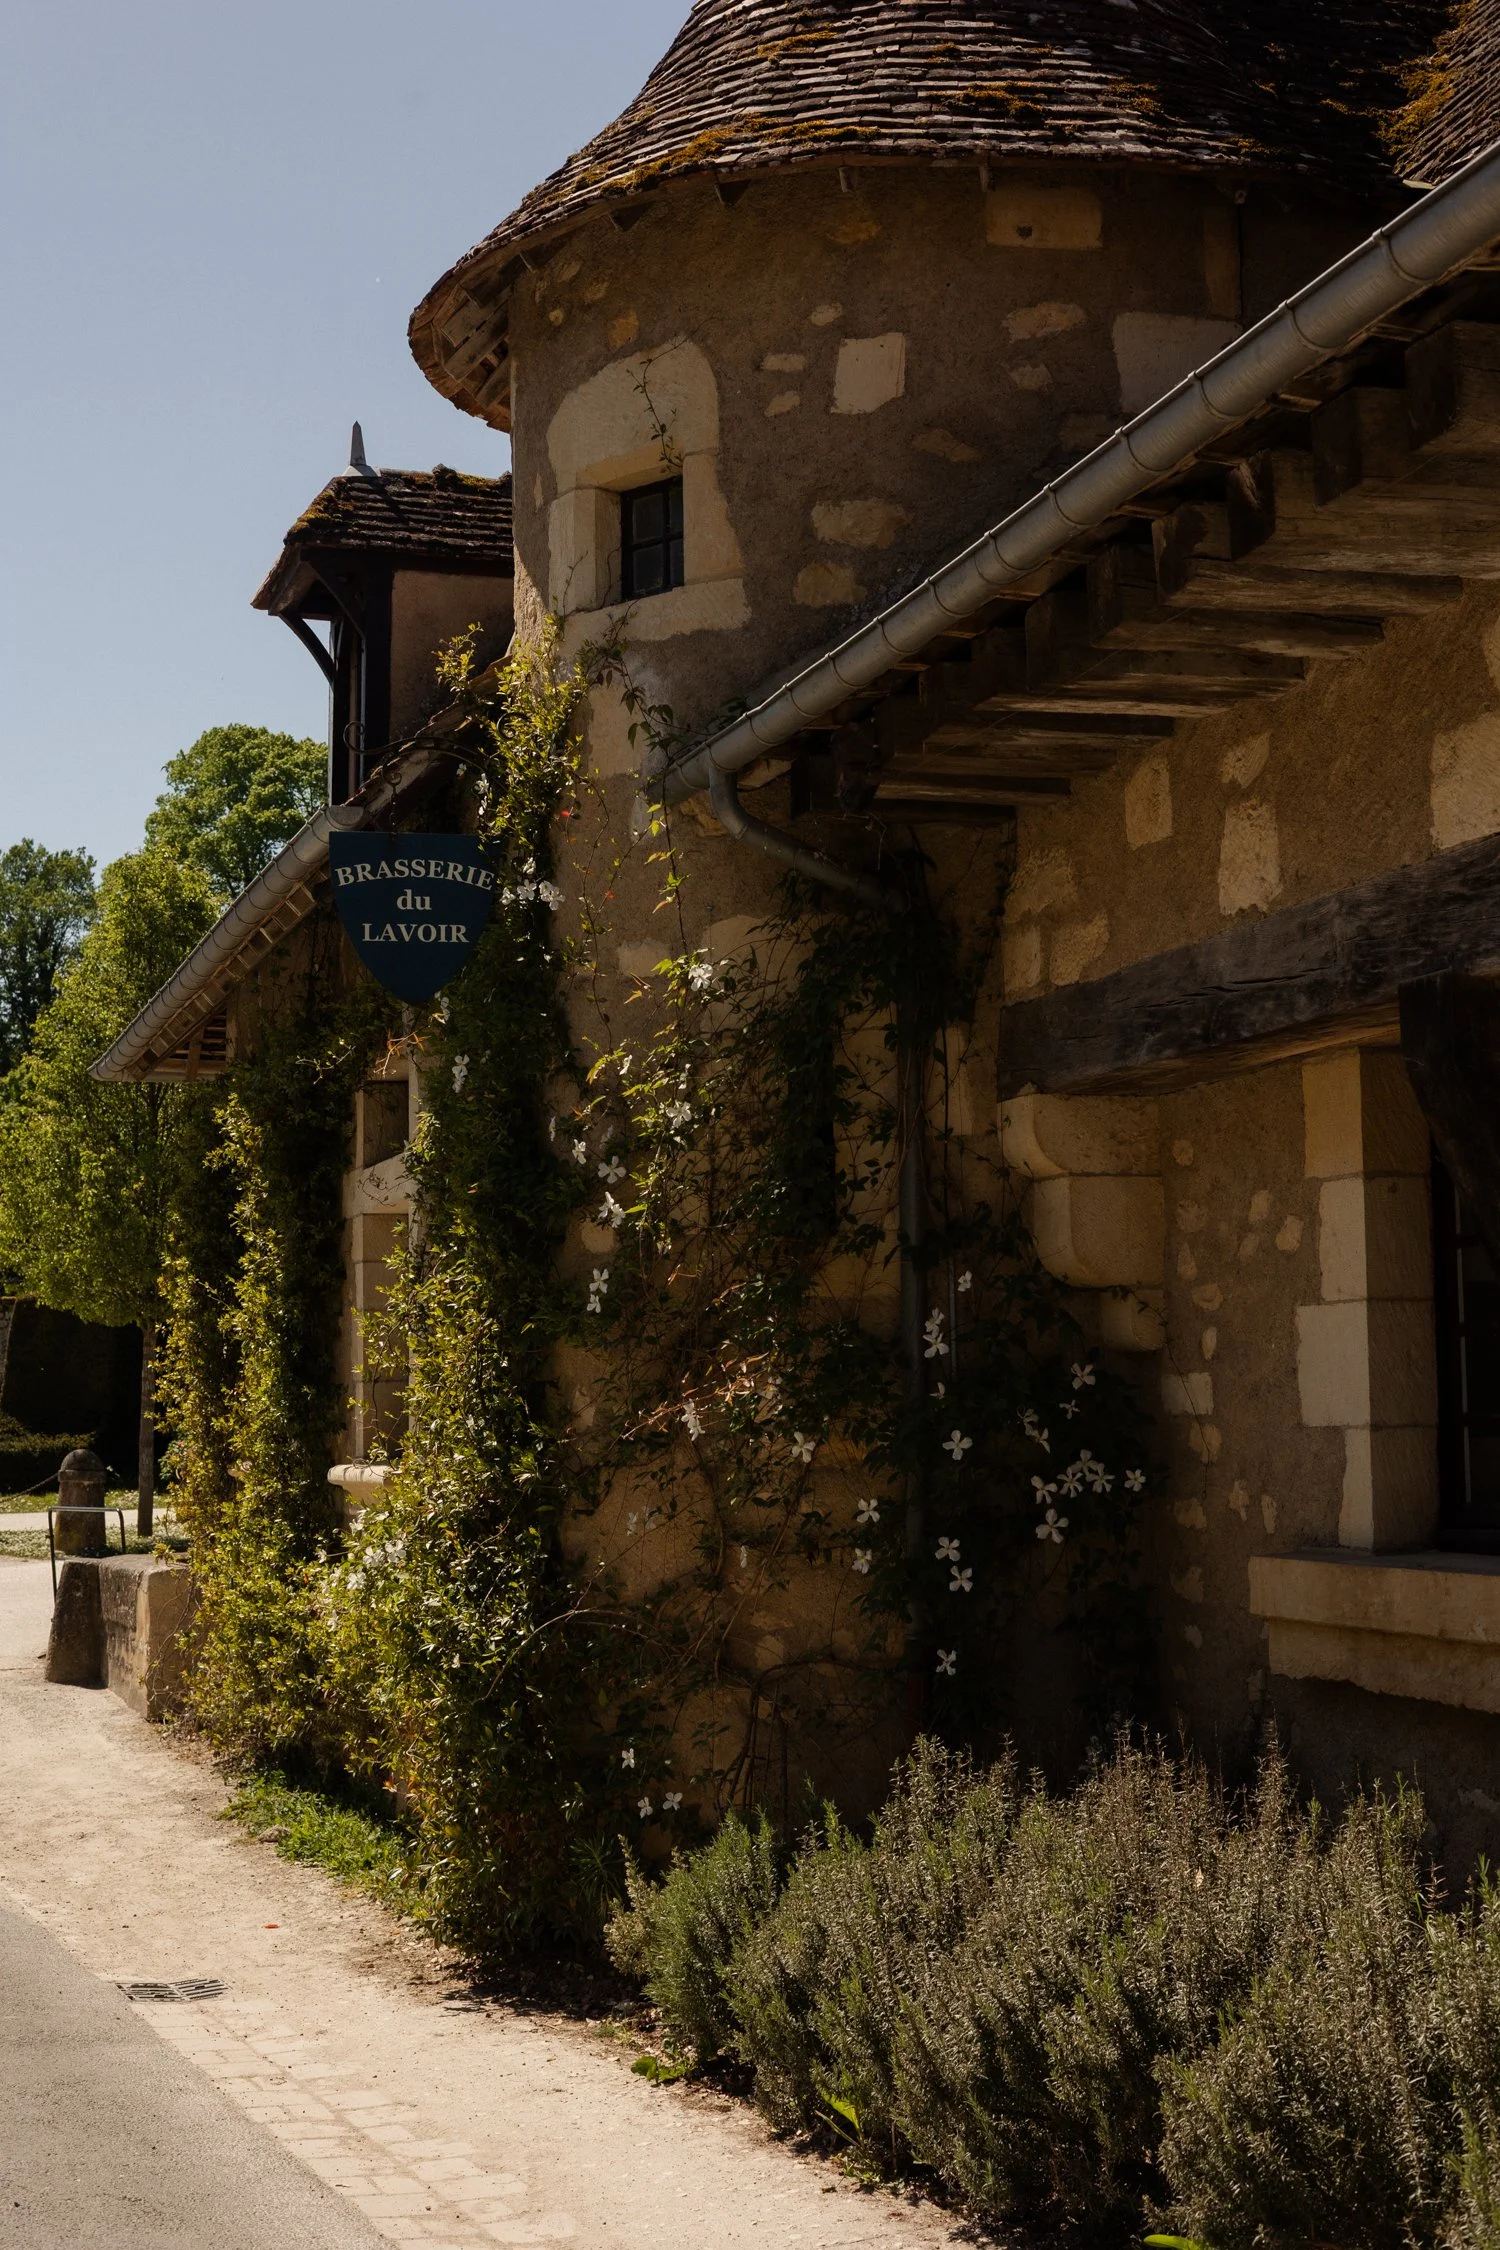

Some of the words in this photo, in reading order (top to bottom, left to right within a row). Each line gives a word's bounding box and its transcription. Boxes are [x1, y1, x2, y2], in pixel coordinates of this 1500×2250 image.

[334, 858, 495, 891] BRASSERIE
[396, 888, 432, 911] du
[362, 923, 470, 943] LAVOIR
